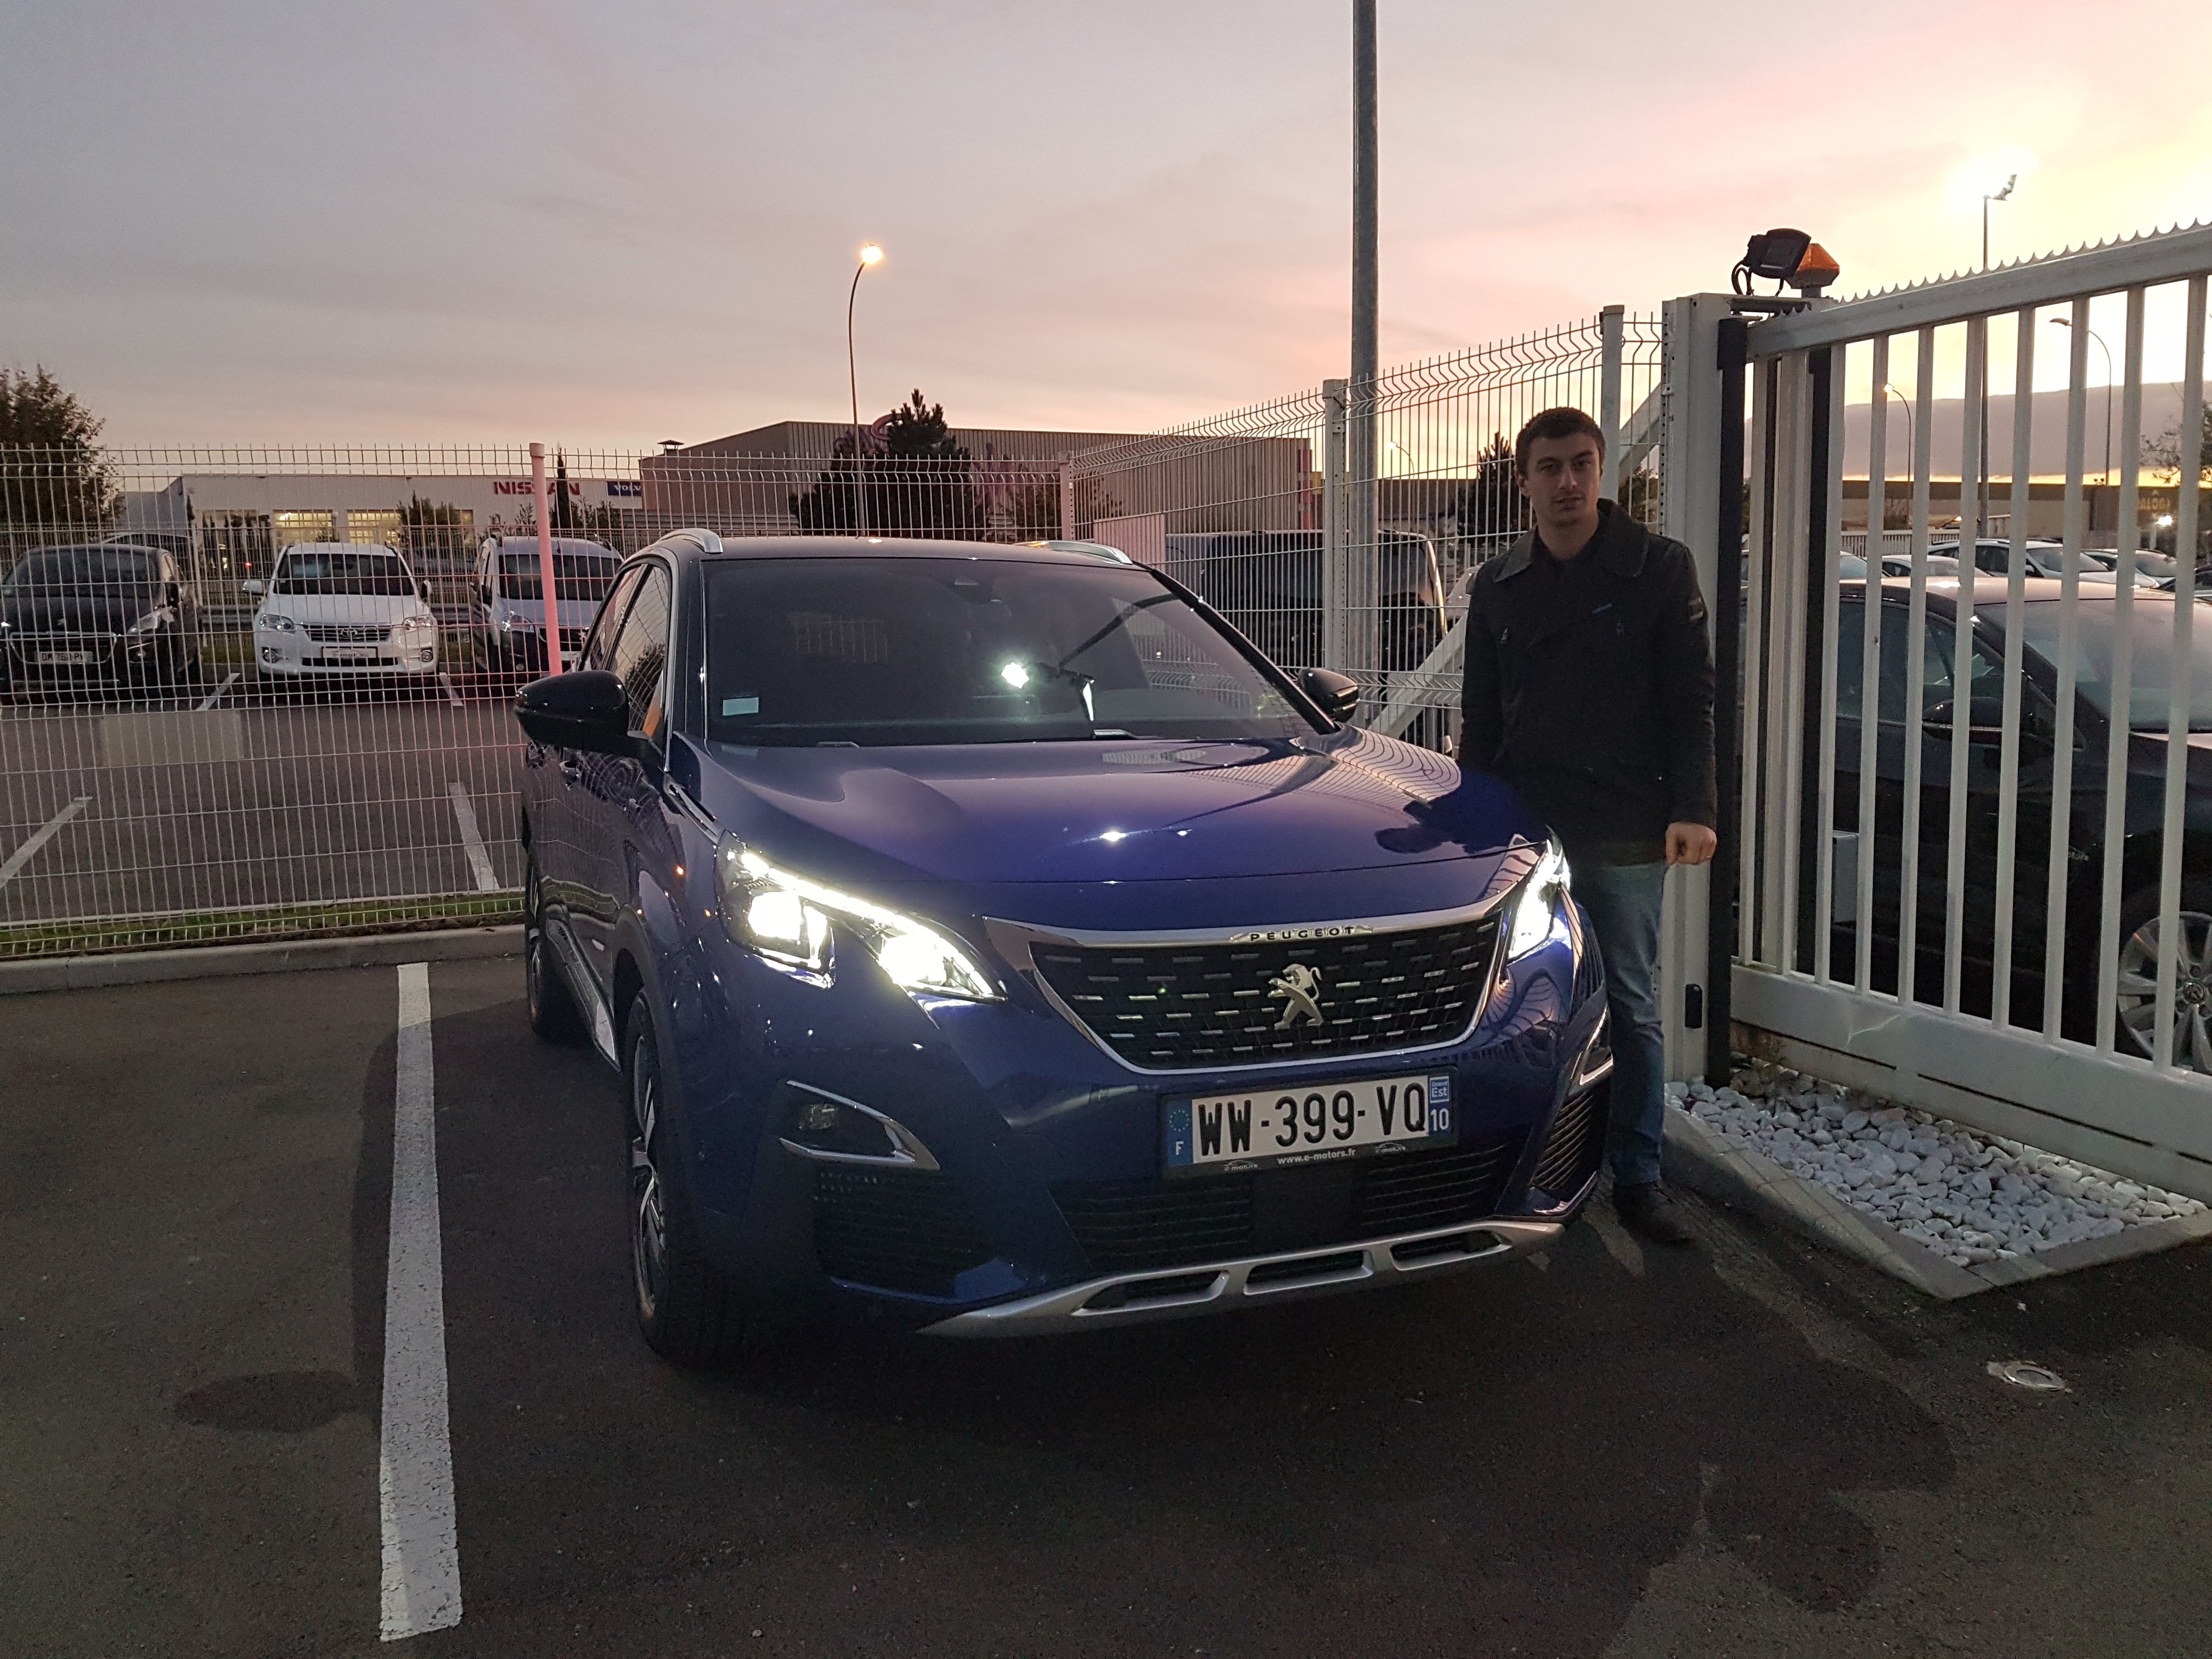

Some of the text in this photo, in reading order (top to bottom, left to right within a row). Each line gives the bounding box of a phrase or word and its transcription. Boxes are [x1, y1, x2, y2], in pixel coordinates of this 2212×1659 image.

[494, 481, 580, 495] NISAN
[1250, 927, 1353, 941] PEUGEOT
[1431, 1087, 1448, 1097] Est
[1430, 1108, 1449, 1131] 10
[1175, 1141, 1184, 1155] F
[1277, 1148, 1356, 1165] www.e-motors.fr
